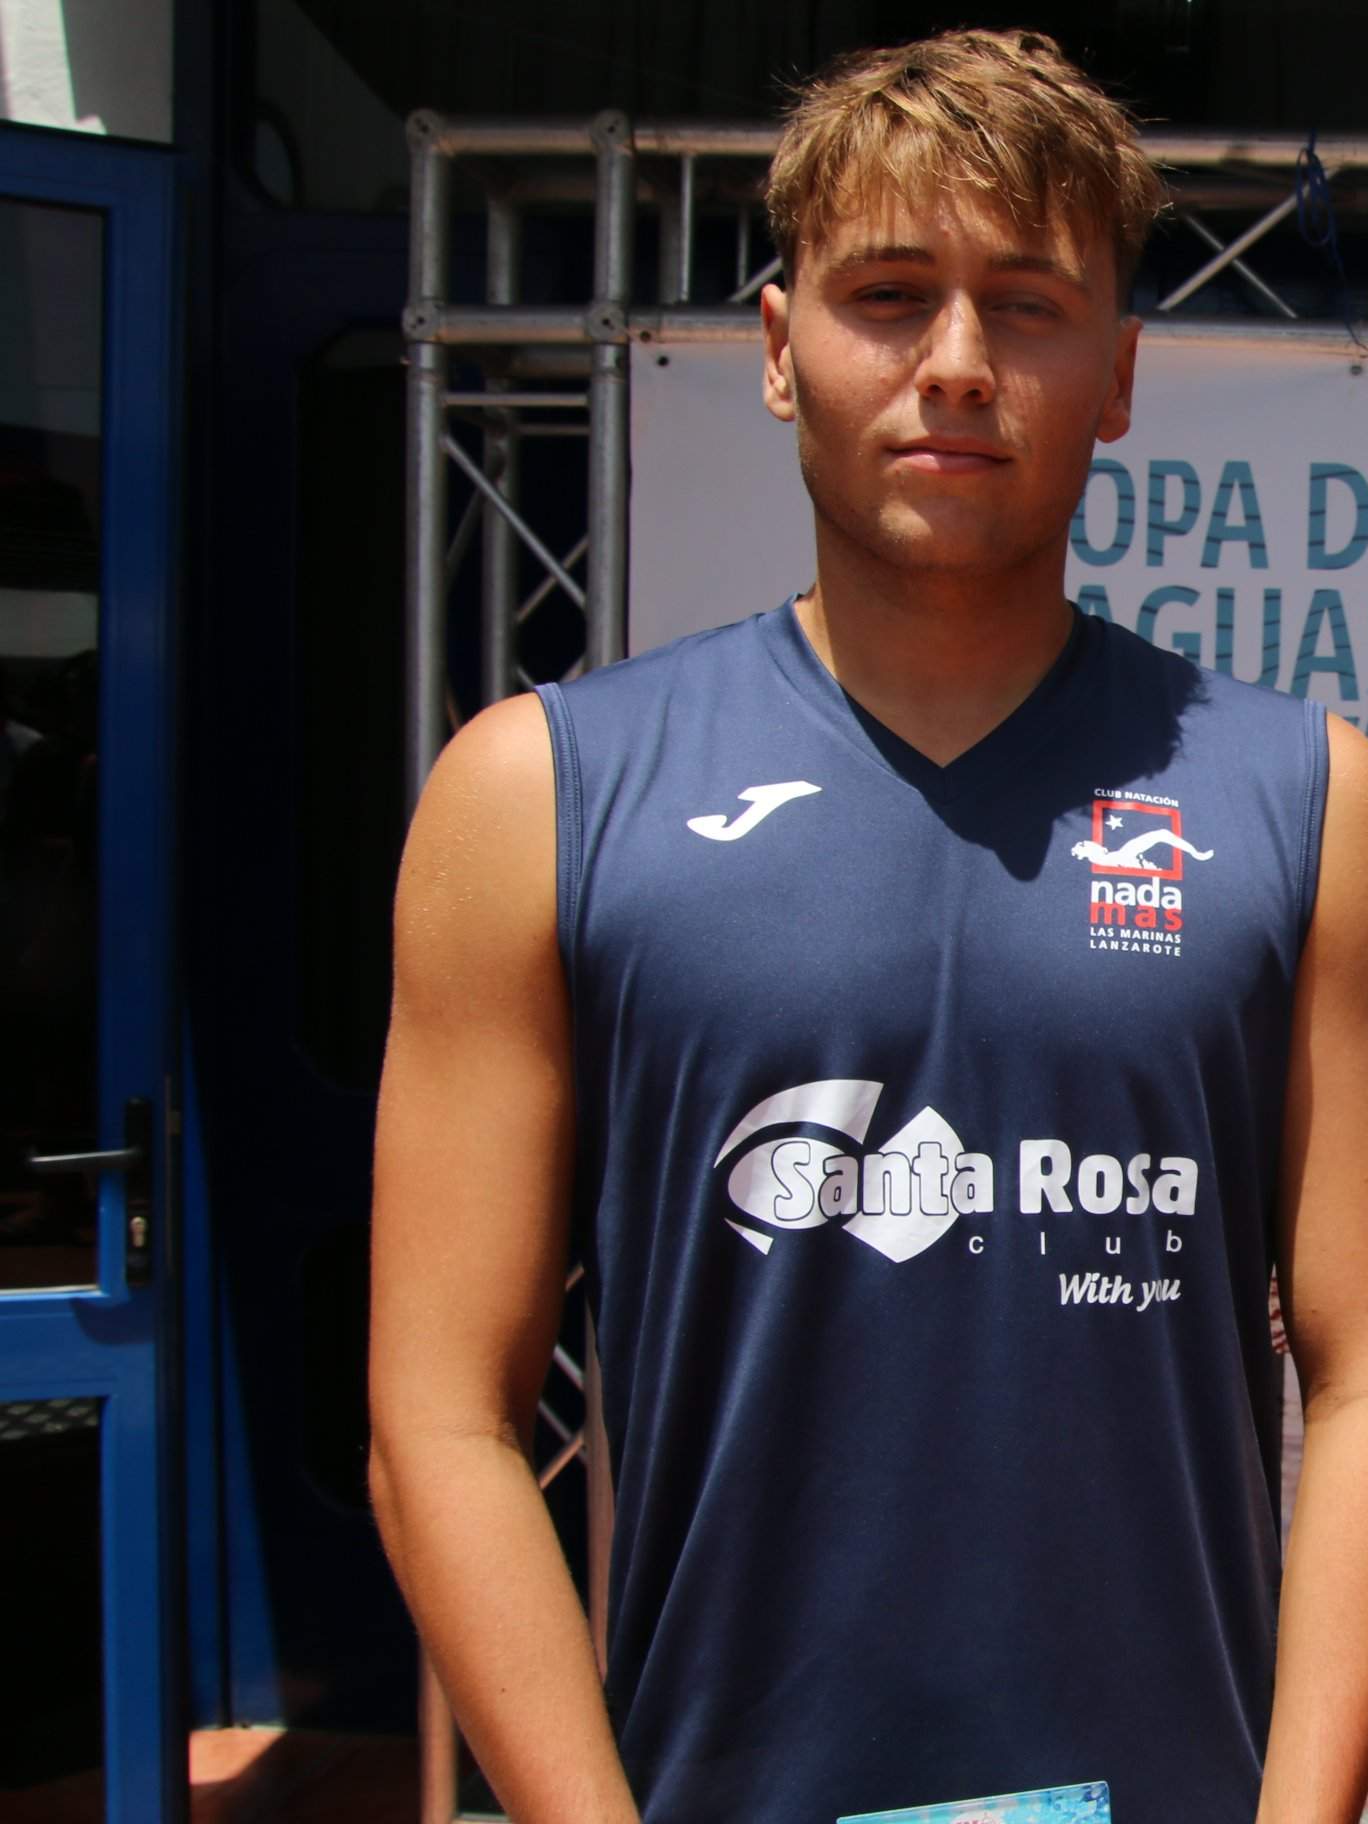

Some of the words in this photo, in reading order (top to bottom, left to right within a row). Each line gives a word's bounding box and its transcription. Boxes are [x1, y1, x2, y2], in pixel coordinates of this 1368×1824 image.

[1069, 458, 1269, 570] OPA
[1094, 787, 1122, 799] CLUB
[1125, 791, 1179, 808] NATACIÓN
[1091, 876, 1182, 910] nada
[1090, 927, 1115, 938] LAS
[1120, 928, 1182, 944] MARINAS
[1090, 939, 1182, 957] LANZAROTE
[771, 1140, 995, 1222] Santa
[1019, 1138, 1200, 1217] Rosa
[1058, 1272, 1133, 1306] With
[1136, 1275, 1181, 1312] you
